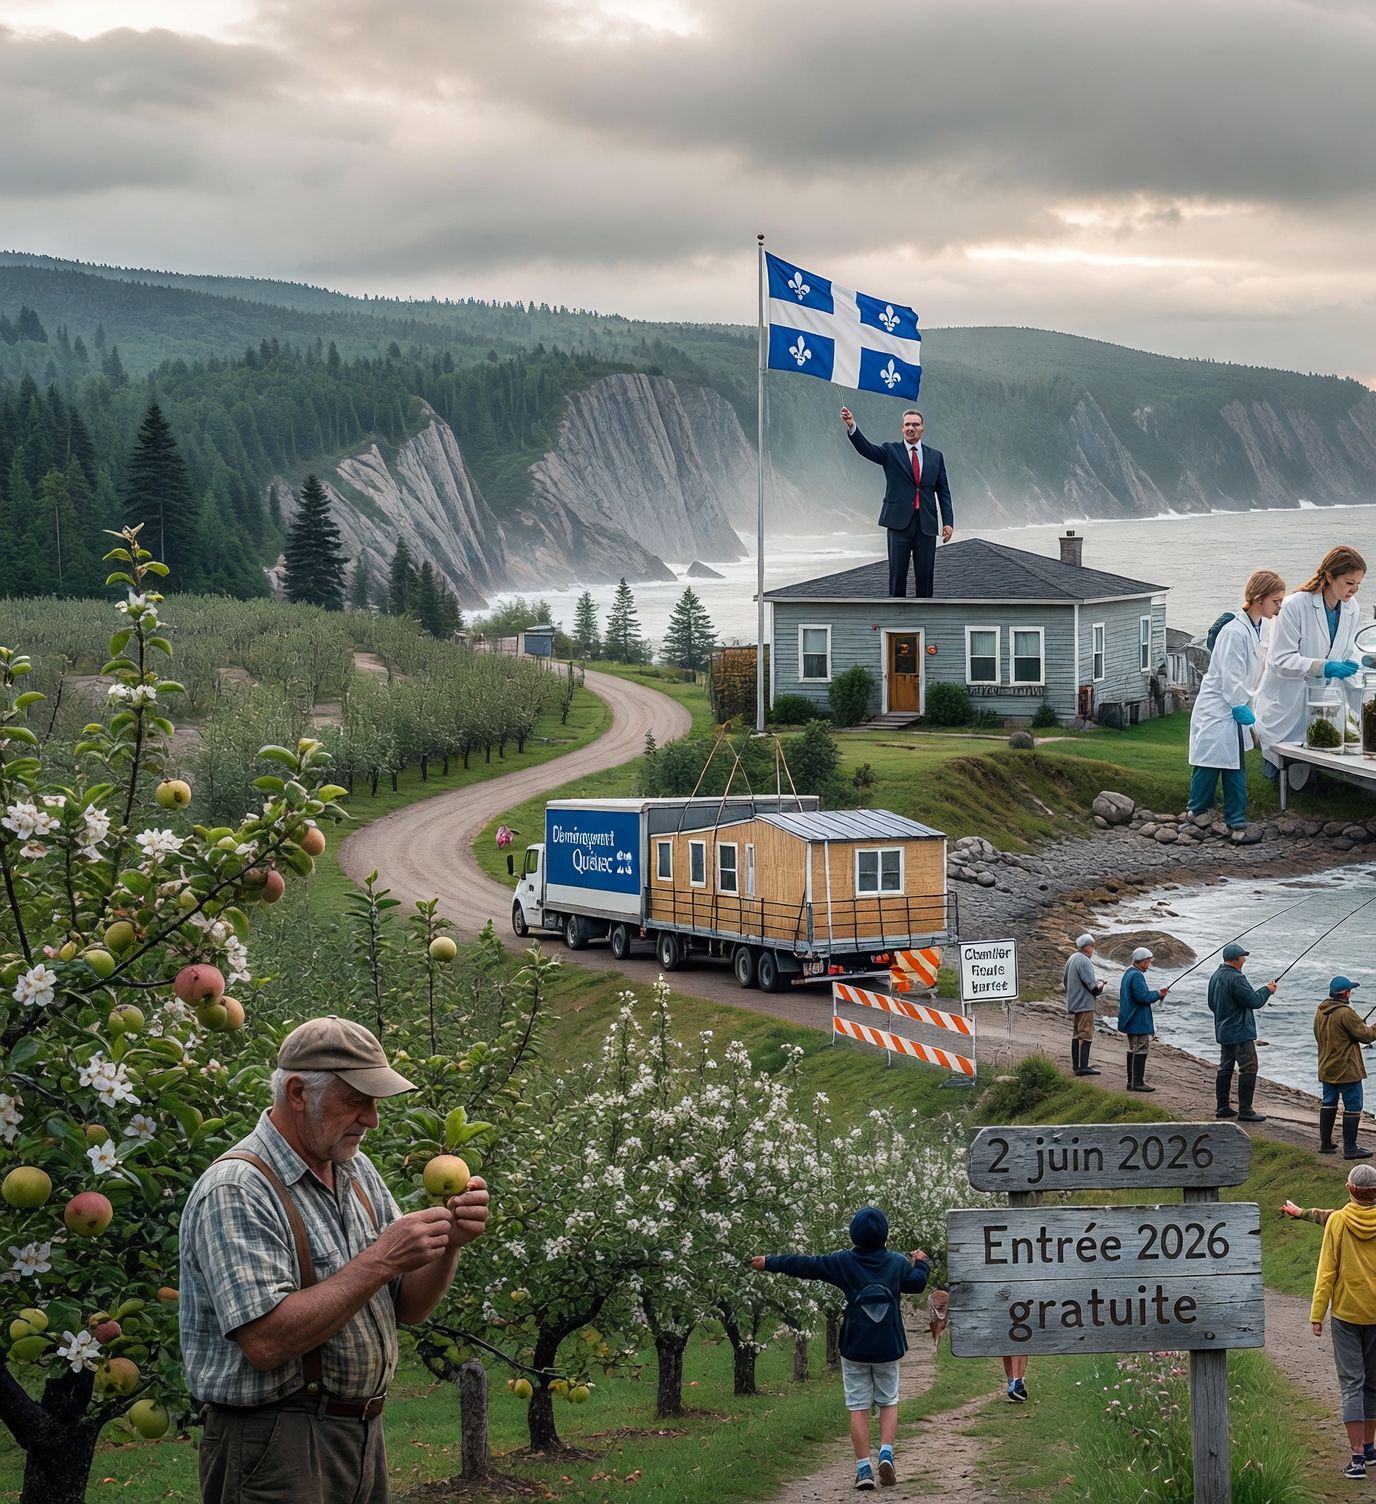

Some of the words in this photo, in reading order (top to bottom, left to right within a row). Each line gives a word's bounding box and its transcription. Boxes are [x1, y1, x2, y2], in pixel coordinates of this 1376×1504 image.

[987, 1137, 1010, 1174] 2
[1027, 1136, 1104, 1184] juin
[1118, 1133, 1214, 1171] 2026
[983, 1222, 1122, 1264] Entrée
[1137, 1221, 1230, 1260] 2026
[1008, 1284, 1197, 1343] gratuite
